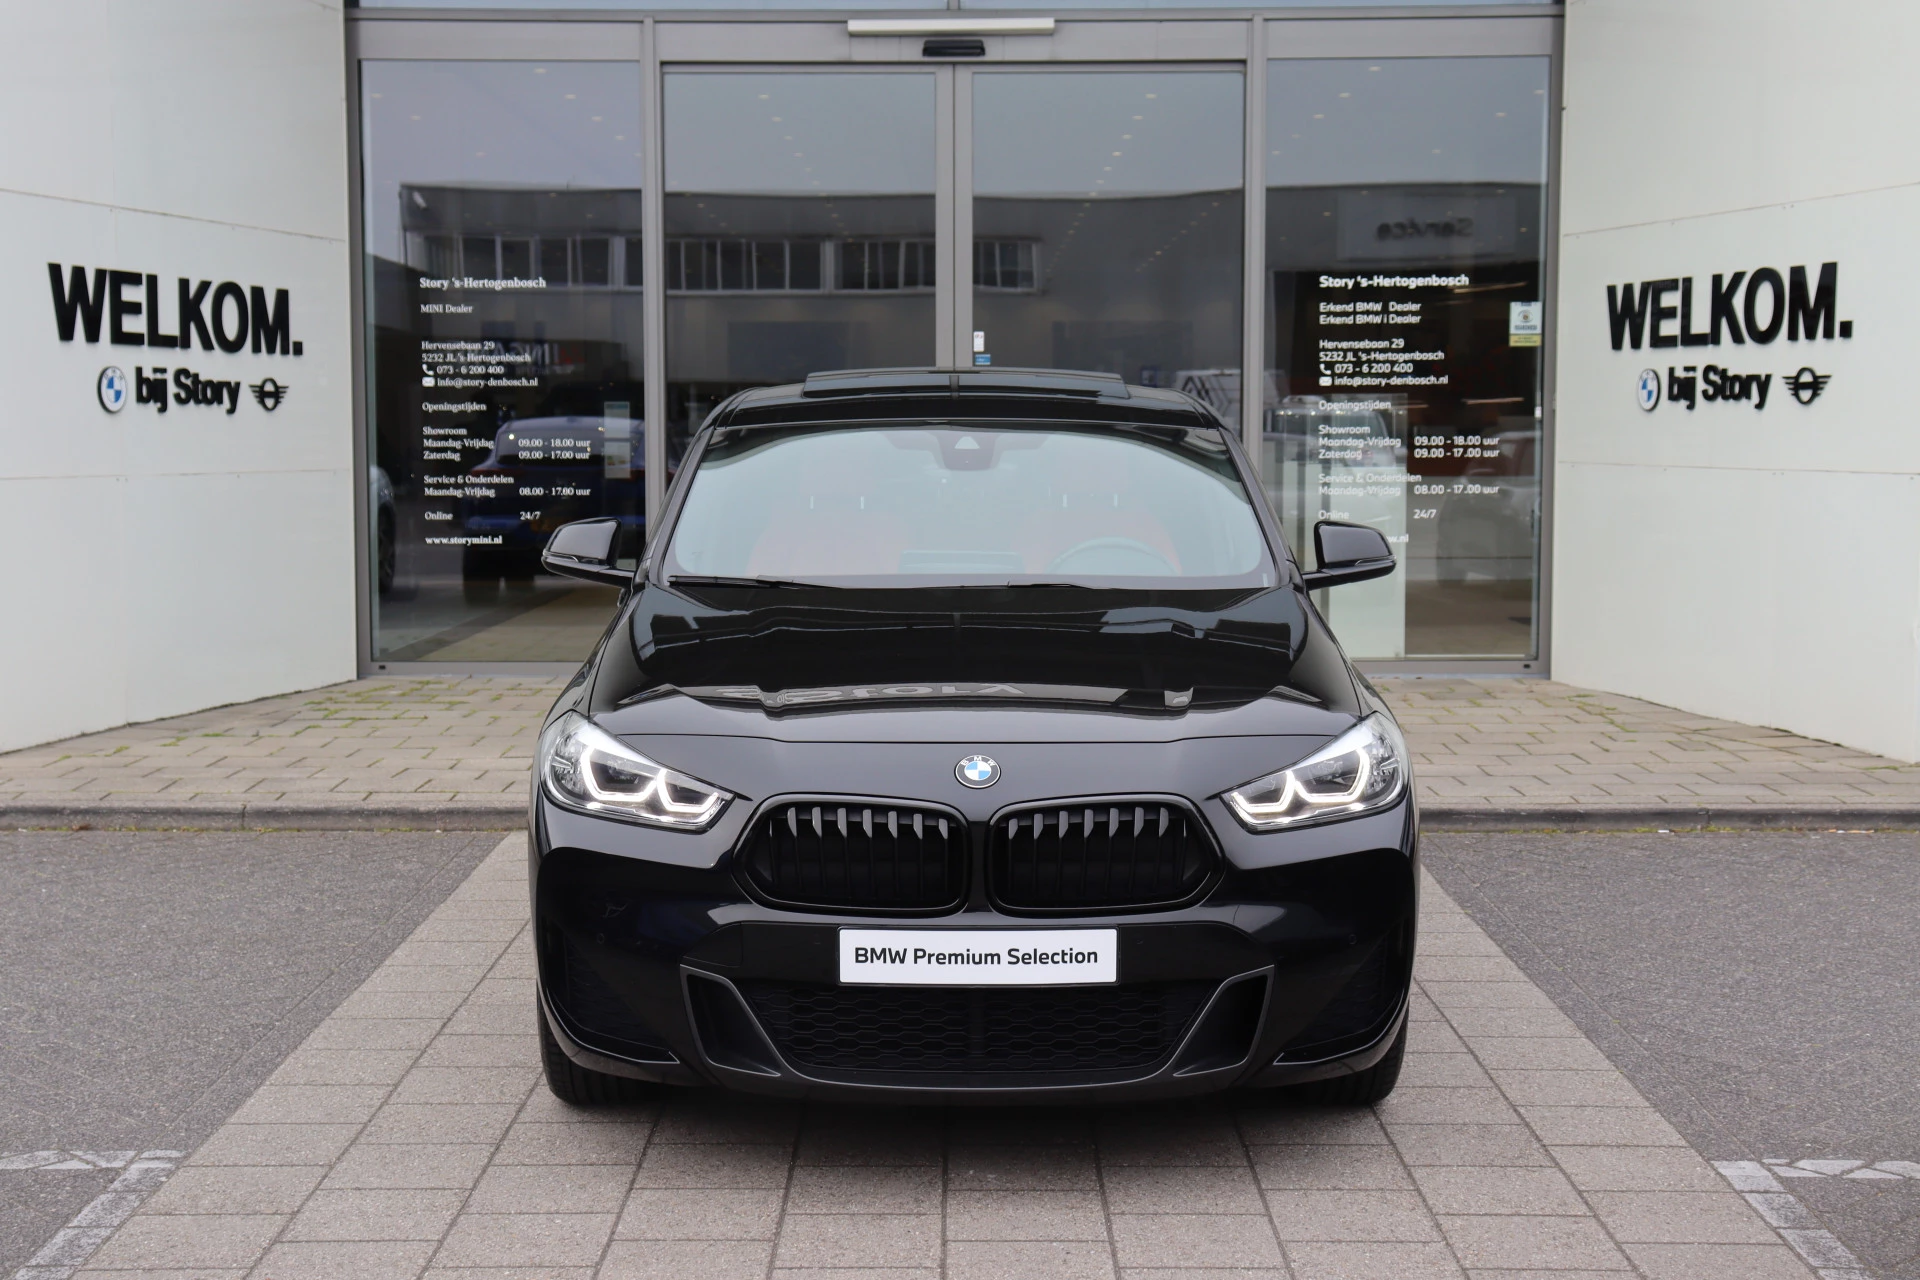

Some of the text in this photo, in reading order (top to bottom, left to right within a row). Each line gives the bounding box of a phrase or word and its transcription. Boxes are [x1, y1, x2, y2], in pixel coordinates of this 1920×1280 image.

[419, 277, 546, 291] Story 's-Hertogenbosch
[1319, 274, 1469, 289] Story 's-Hertogenbosch
[48, 262, 303, 356] WELKOM.
[421, 304, 473, 313] MINI Dealer
[1319, 302, 1421, 312] Erkend BMW Dealer
[1607, 262, 1853, 351] WELKOM.
[1319, 314, 1421, 325] Erkend BMW i Dealer
[421, 341, 495, 350] Hervensebaan 29
[1319, 338, 1404, 349] Hervensebaan 29
[1319, 350, 1444, 362] 5232 JL 's-Hertogenbosch
[436, 365, 454, 374] 073
[461, 365, 466, 374] 6
[469, 365, 485, 374] 200
[487, 365, 504, 374] 400
[1334, 364, 1353, 373] 073
[1362, 363, 1369, 373] 6
[1372, 363, 1391, 373] 200
[1393, 363, 1413, 373] 400
[437, 377, 538, 388] info@story-denbosch.nl
[1334, 375, 1448, 387] info@story-denbosch.nl
[135, 366, 241, 414] bij Story
[1668, 364, 1772, 410] bij Story
[422, 402, 486, 412] Openingstijden
[1319, 400, 1391, 412] Openingstijden
[422, 427, 467, 435] Showroom
[1318, 425, 1370, 434] Showroom
[423, 439, 494, 448] Maandag-Vrijdag
[518, 439, 543, 447] 09.00
[550, 439, 574, 447] 18.00
[1318, 437, 1401, 448] Maandag-Vrijdag
[1414, 436, 1444, 446] 09.00
[1453, 436, 1481, 445] 18.00
[423, 451, 461, 461] Zaterdag
[518, 451, 543, 459] 09.00
[550, 451, 574, 459] 17.00
[1318, 449, 1362, 460] Zaterdag
[1414, 448, 1444, 458] 09.00
[1453, 448, 1481, 458] 17.00
[424, 475, 514, 483] Service & Onderdelen
[1318, 473, 1422, 483] Service & Onderdelen
[424, 487, 495, 498] Maandag-Vrijdag
[519, 488, 544, 496] 08.00
[551, 488, 574, 496] 17.00
[1318, 485, 1401, 497] Maandag-Vrijdag
[1414, 485, 1444, 494] 08.00
[1453, 485, 1481, 494] 17.00
[1483, 486, 1499, 494] uur
[425, 511, 541, 520] Online 24/7
[1318, 509, 1436, 519] Online 24/7
[425, 535, 502, 546] www.storymini.nl
[961, 756, 995, 766] BMW
[855, 947, 1098, 965] BMW Premium Selection
